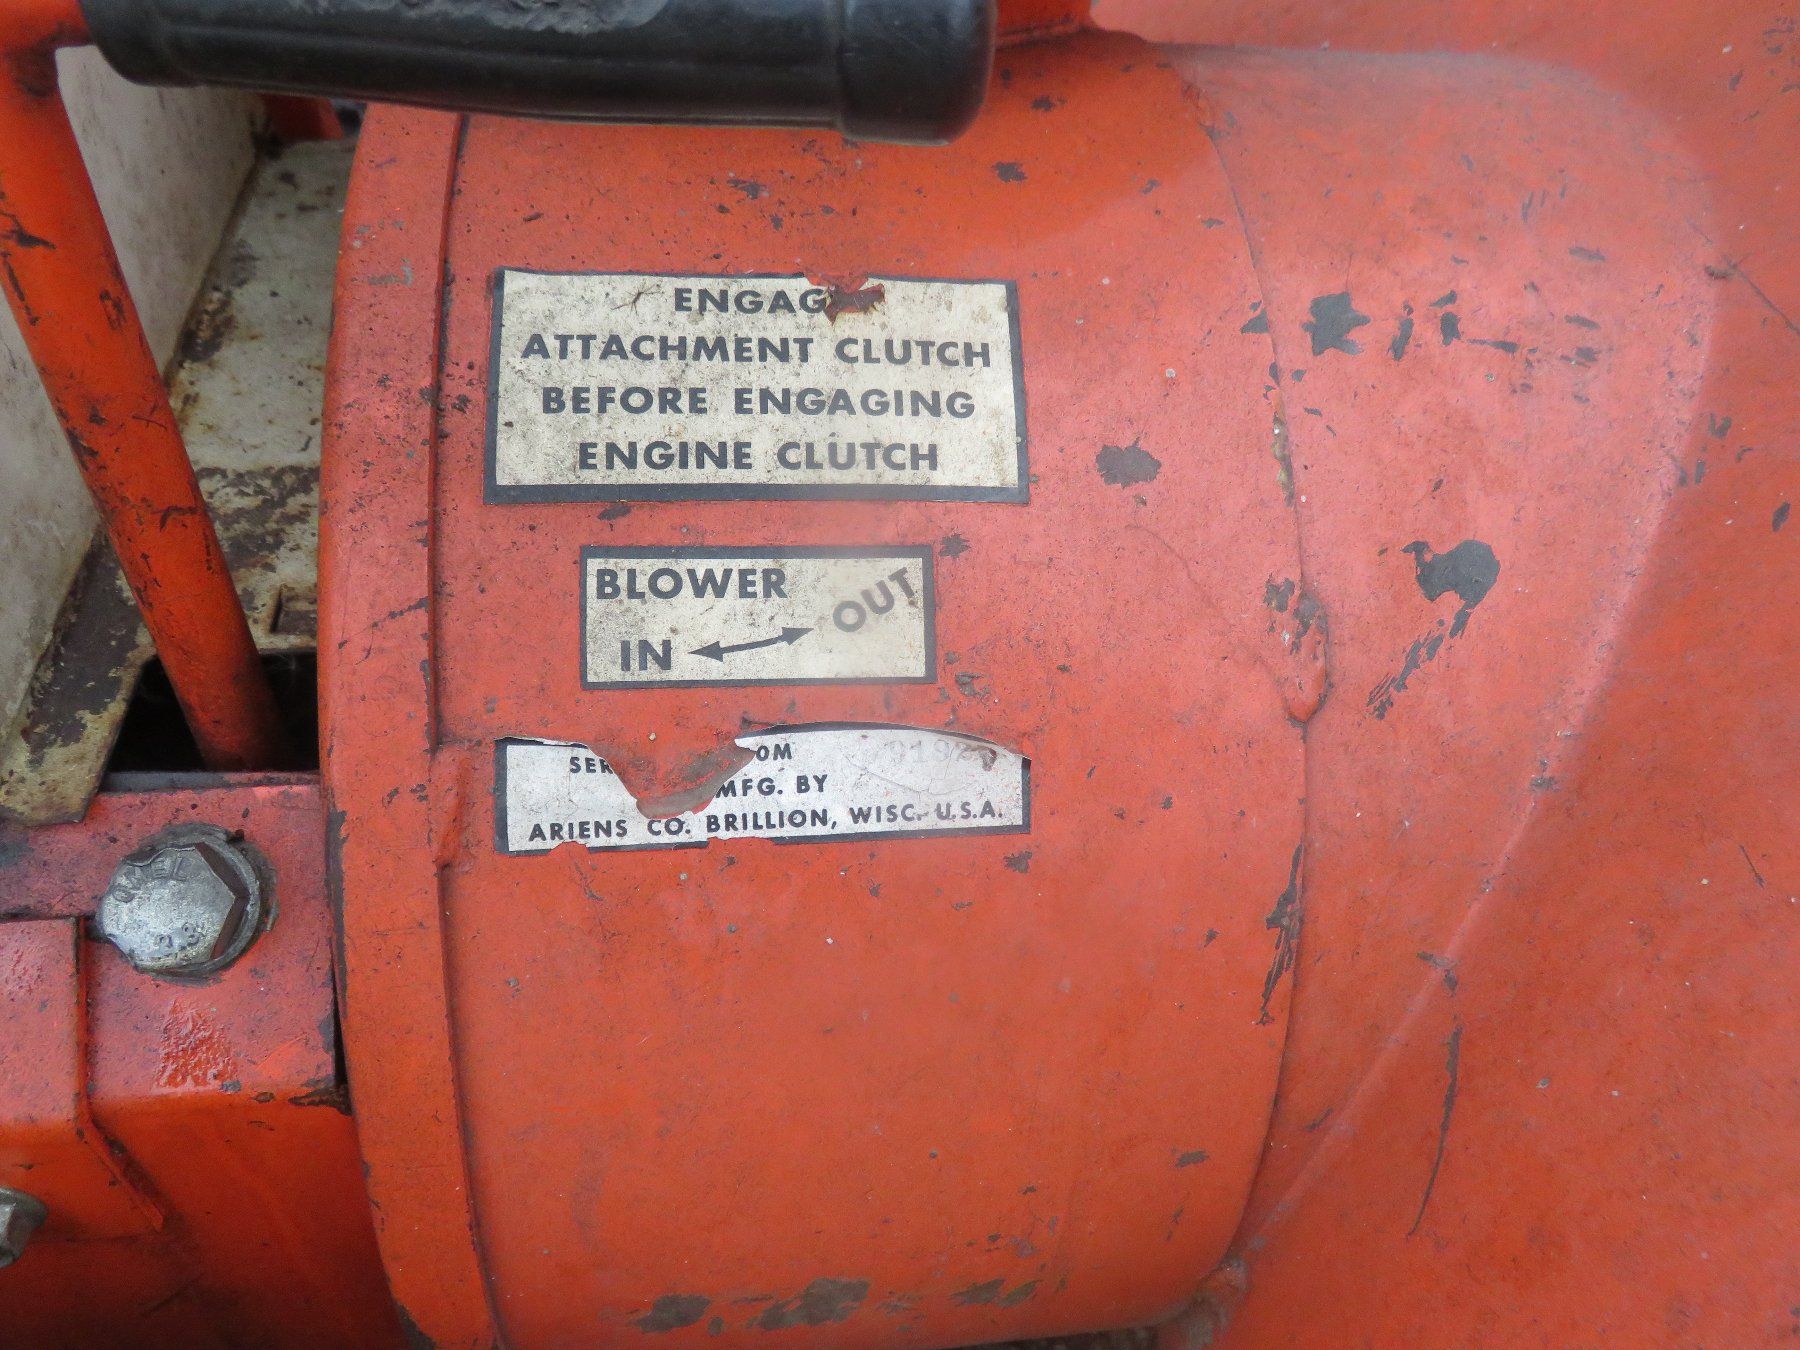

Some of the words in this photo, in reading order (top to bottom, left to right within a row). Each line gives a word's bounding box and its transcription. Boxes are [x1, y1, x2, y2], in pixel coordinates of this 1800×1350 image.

[674, 288, 828, 314] ENGAG
[521, 334, 813, 362] ATTACHMENT
[836, 337, 991, 367] CLUTCH
[543, 386, 708, 414] BEFORE
[734, 388, 975, 418] ENGAGING
[578, 441, 753, 470] ENGINE
[777, 442, 938, 471] CLUTCH
[596, 568, 788, 599] BLOWER
[832, 567, 918, 633] OUT
[620, 639, 671, 671] IN
[716, 775, 783, 799] MFG.
[796, 774, 828, 795] BY
[528, 819, 628, 842] ARIENS
[647, 816, 691, 836] CO.
[706, 808, 836, 833] BRILLION,
[935, 801, 1004, 821] U.S.A.
